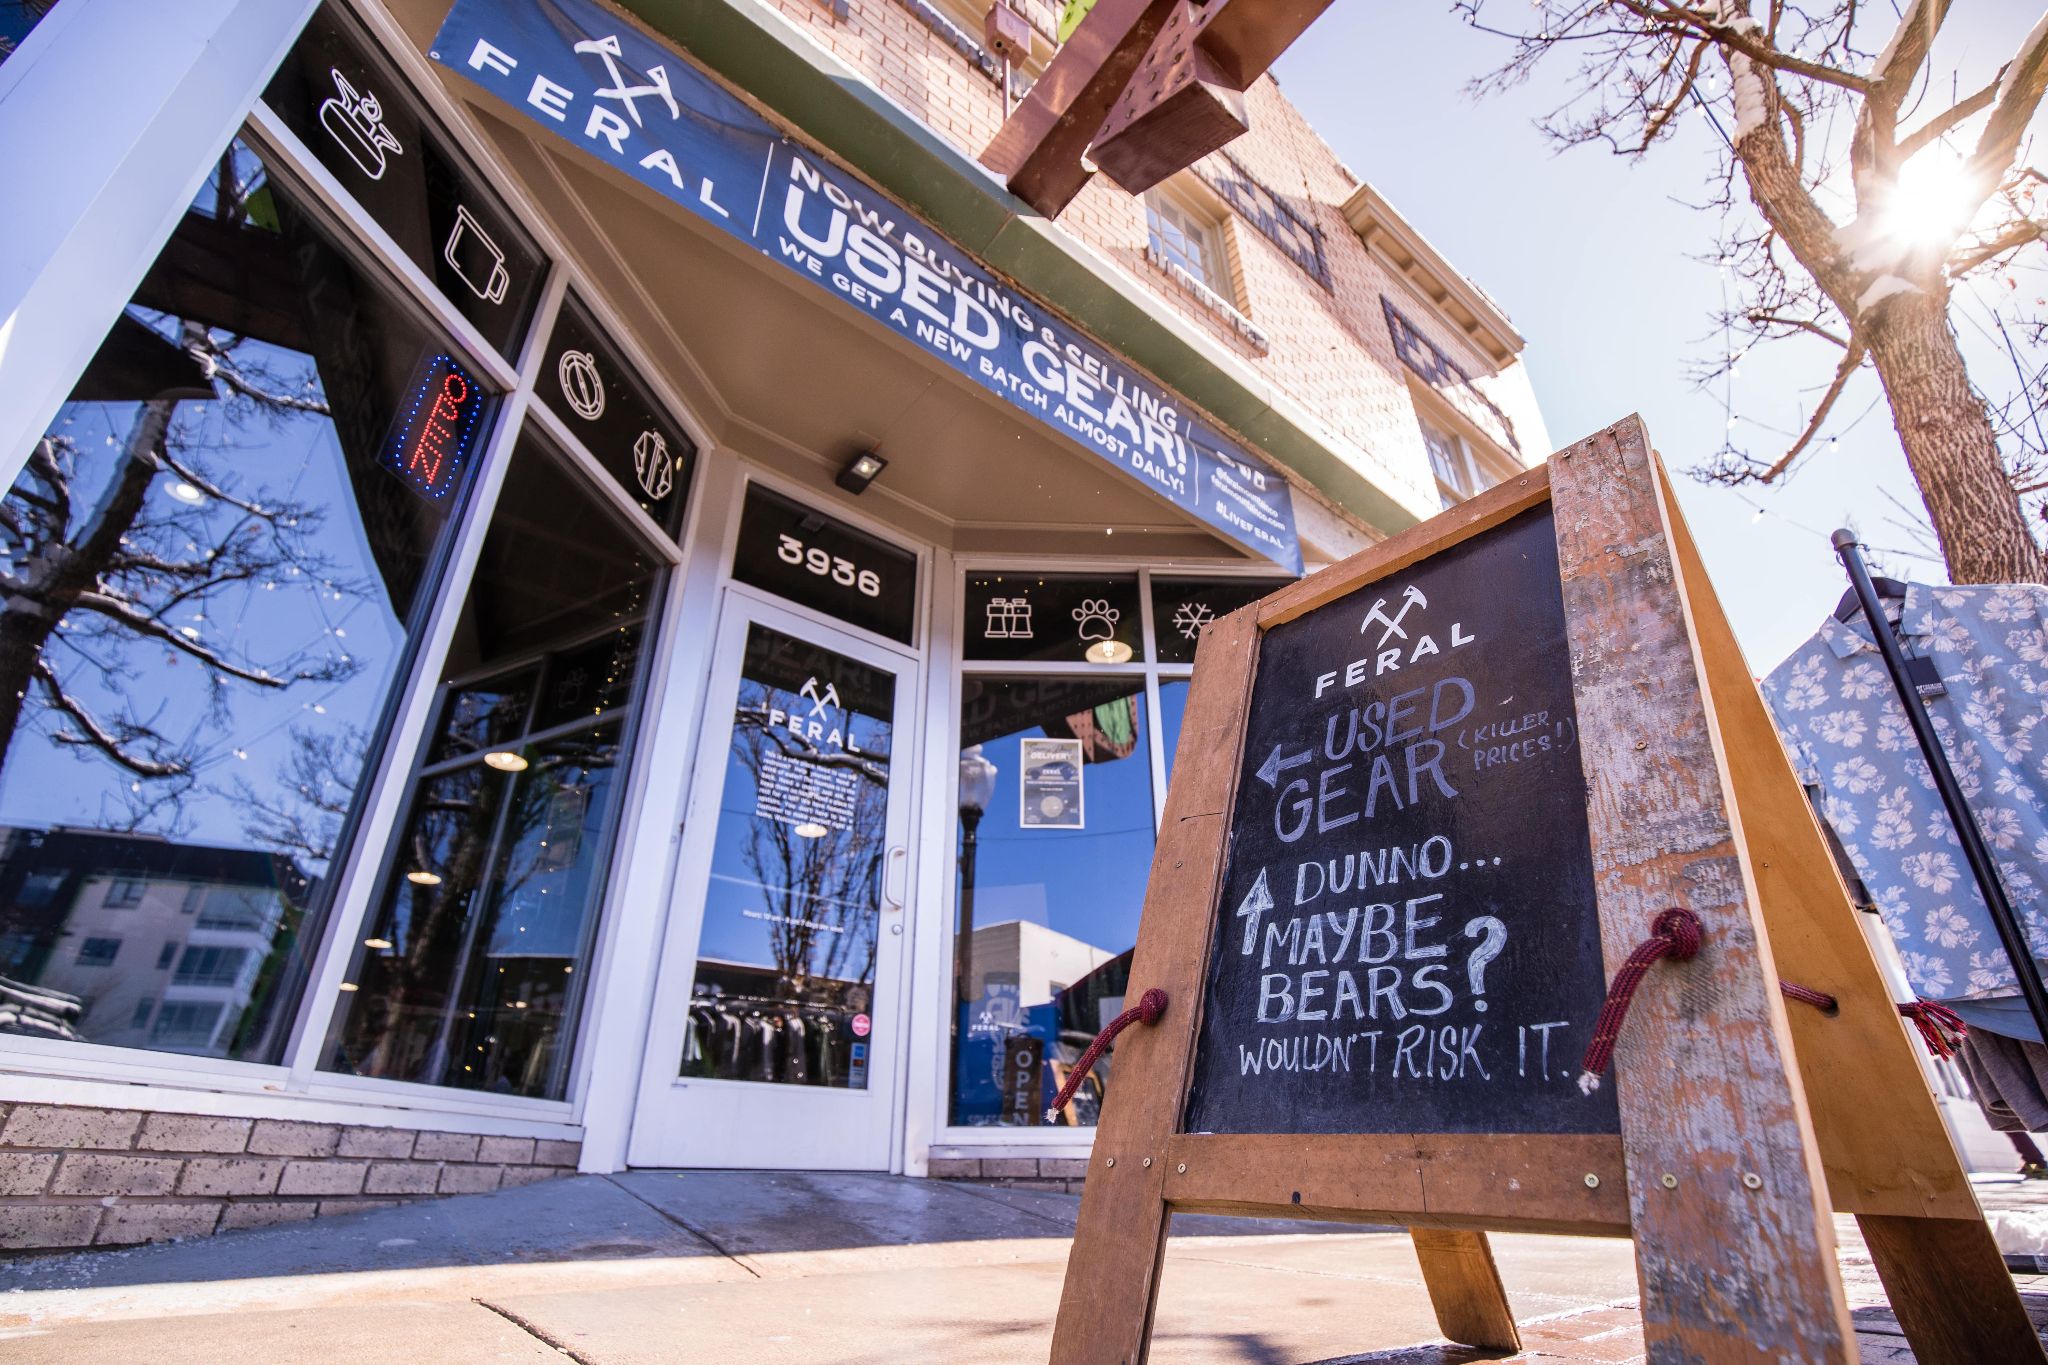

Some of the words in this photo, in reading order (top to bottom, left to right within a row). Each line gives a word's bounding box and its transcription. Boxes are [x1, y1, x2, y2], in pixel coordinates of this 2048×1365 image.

[467, 38, 729, 219] FERAL
[783, 183, 1000, 350] USED
[1022, 340, 1187, 475] GEAR!
[789, 156, 896, 237] NOW
[903, 232, 1034, 333] BUYING
[1041, 327, 1060, 352] &
[1065, 344, 1178, 432] SELLING
[779, 236, 823, 277] WE
[832, 273, 883, 310] GET
[889, 307, 908, 328] A
[916, 319, 972, 362] NEW
[979, 355, 1048, 410] BATCH
[1053, 404, 1128, 458] ALMOST
[1131, 450, 1185, 495] DAILY!
[409, 373, 468, 485] OPEN
[777, 533, 881, 598] 3936
[1314, 622, 1476, 699] FERAL
[768, 708, 861, 753] FERAL
[1324, 676, 1476, 761] USED
[1274, 738, 1459, 843] GEAR
[1294, 835, 1502, 906] DUNNO...
[1261, 893, 1449, 970] MAYBE
[971, 1023, 1000, 1032] FERAL
[1238, 1031, 1384, 1076] WOULDN'T
[1392, 1024, 1491, 1081] RISK
[1518, 1021, 1571, 1082] IT.
[1013, 1049, 1034, 1126] OPEN
